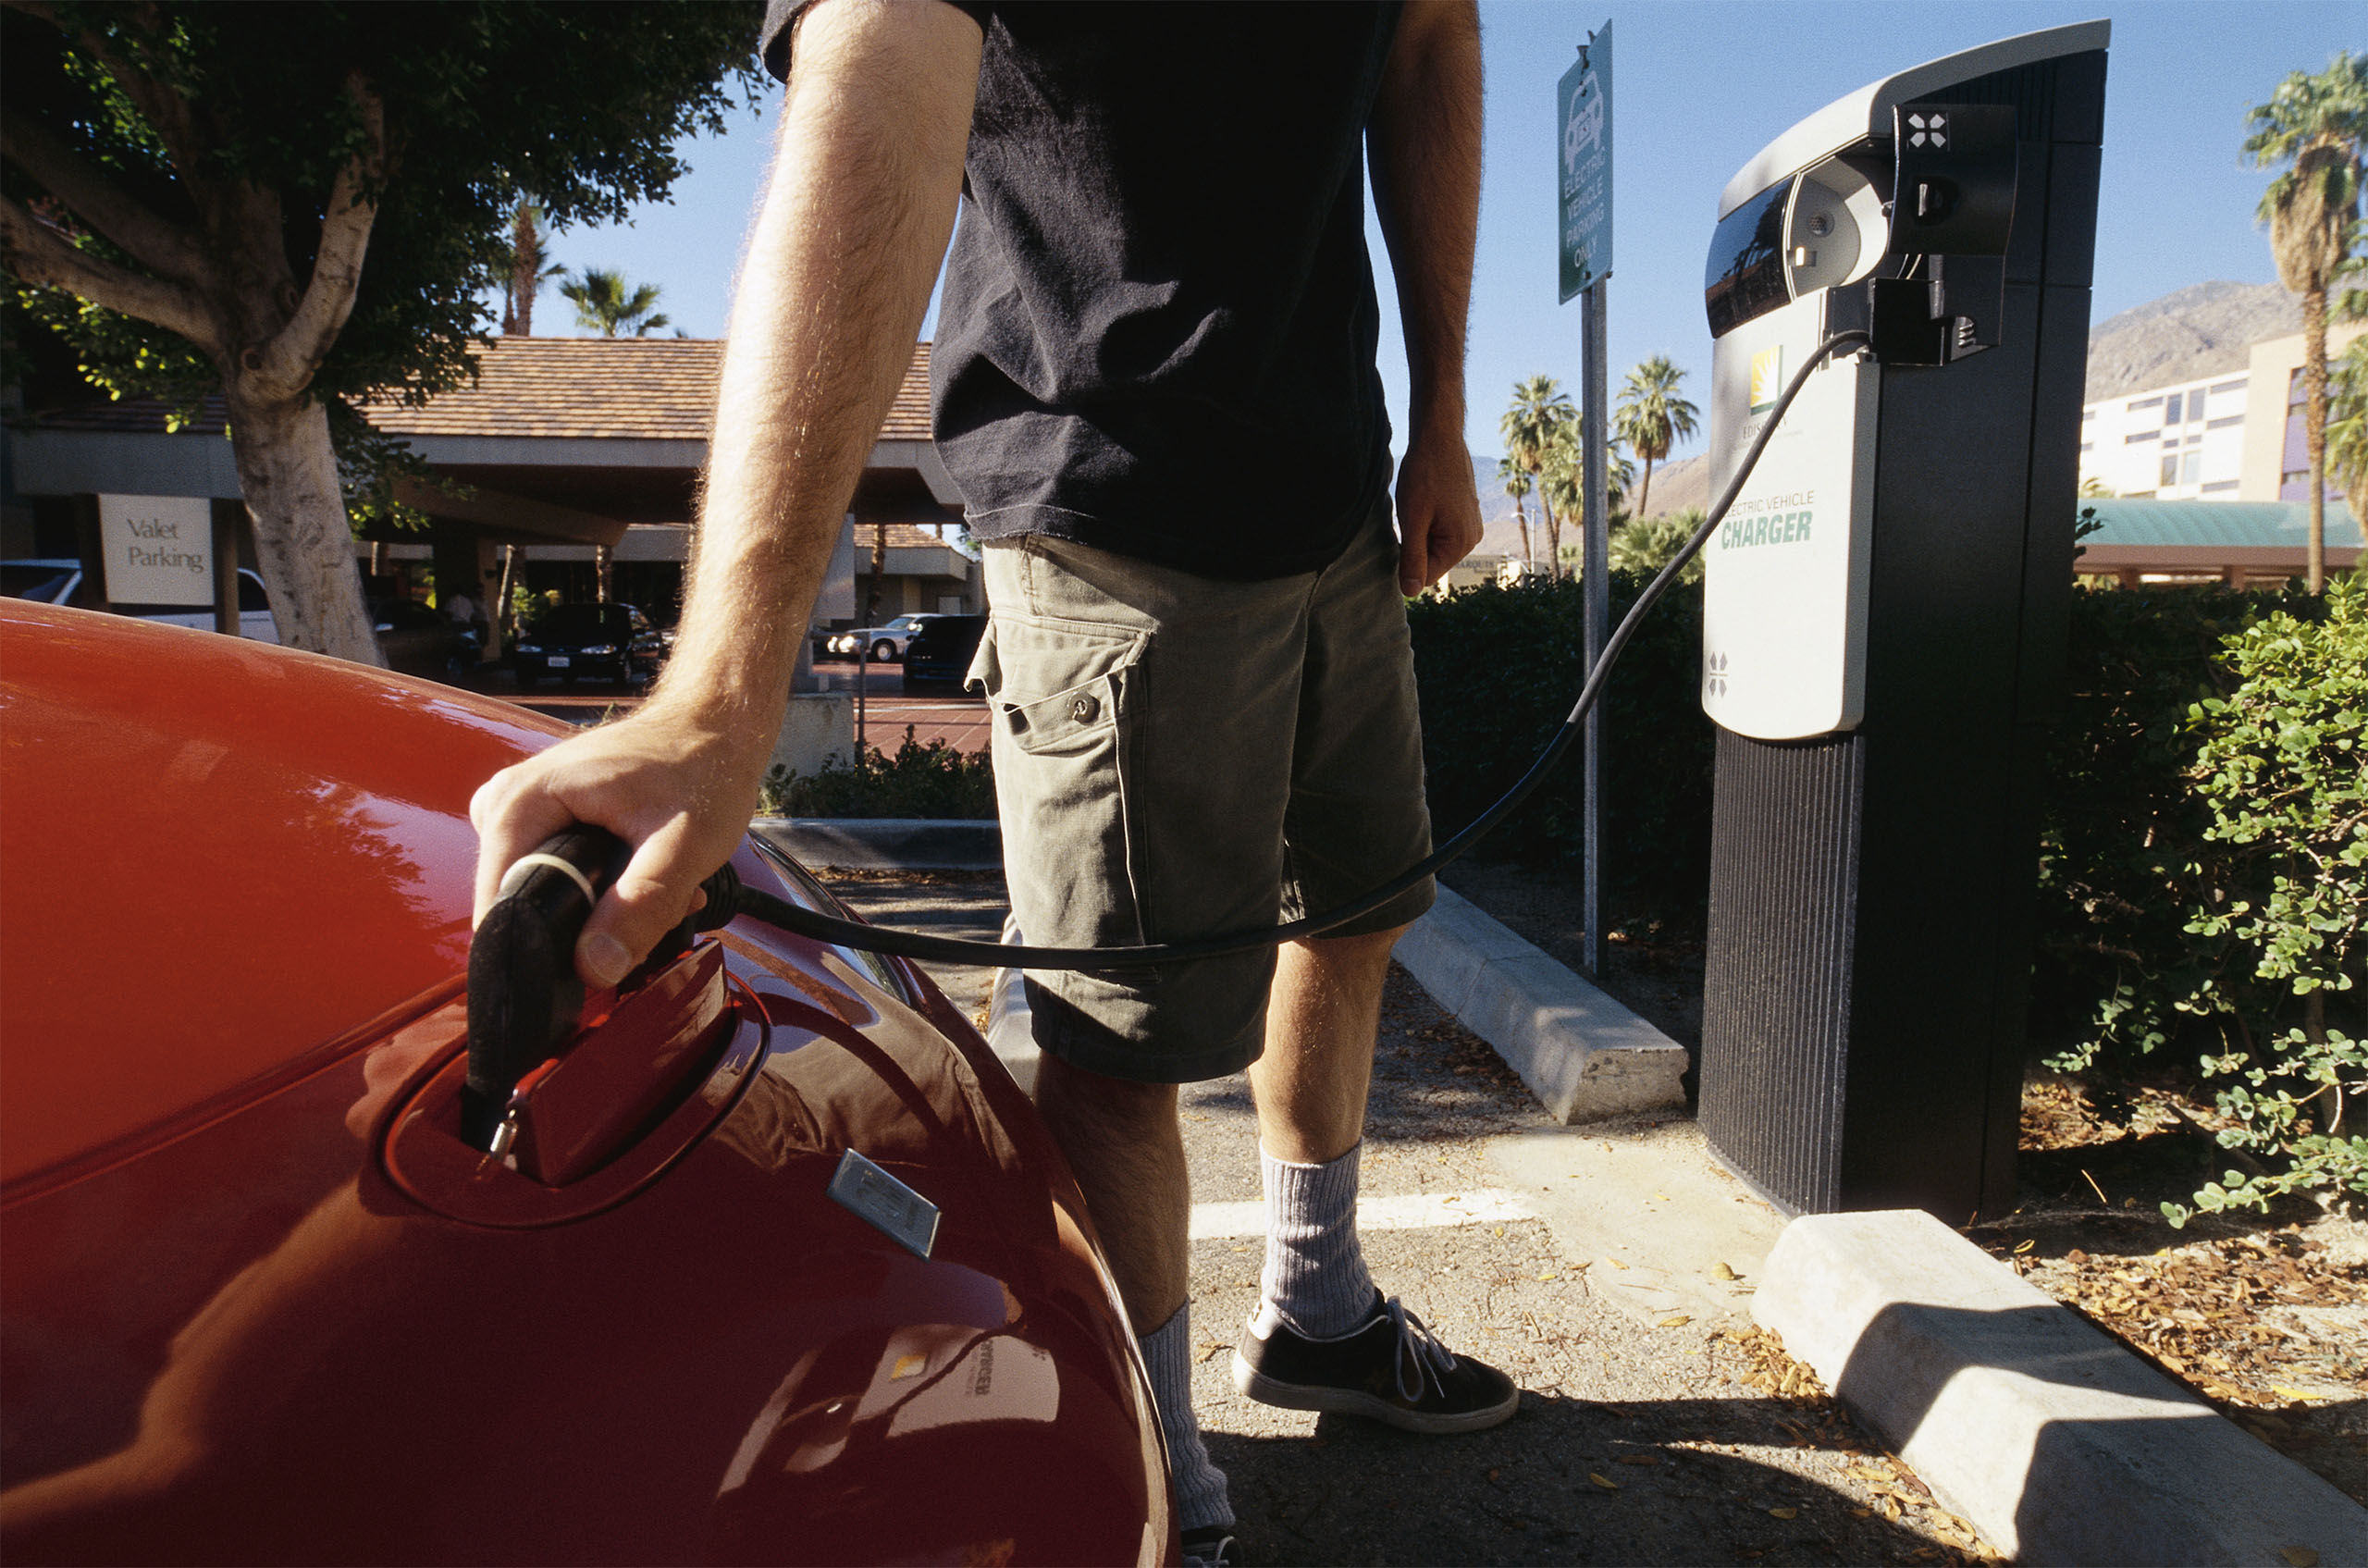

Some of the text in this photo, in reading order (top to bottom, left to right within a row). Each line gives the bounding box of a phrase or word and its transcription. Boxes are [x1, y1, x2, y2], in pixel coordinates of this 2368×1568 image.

[1565, 146, 1606, 200] ELECTRIC
[1567, 175, 1604, 222] VEHICLE
[1566, 202, 1604, 249] PARKING
[1574, 234, 1598, 268] ONLY
[1724, 490, 1814, 517] LECTRIC VEHICLE
[127, 518, 179, 538] Valet
[1721, 511, 1813, 549] CHARGER
[129, 546, 204, 574] Parking
